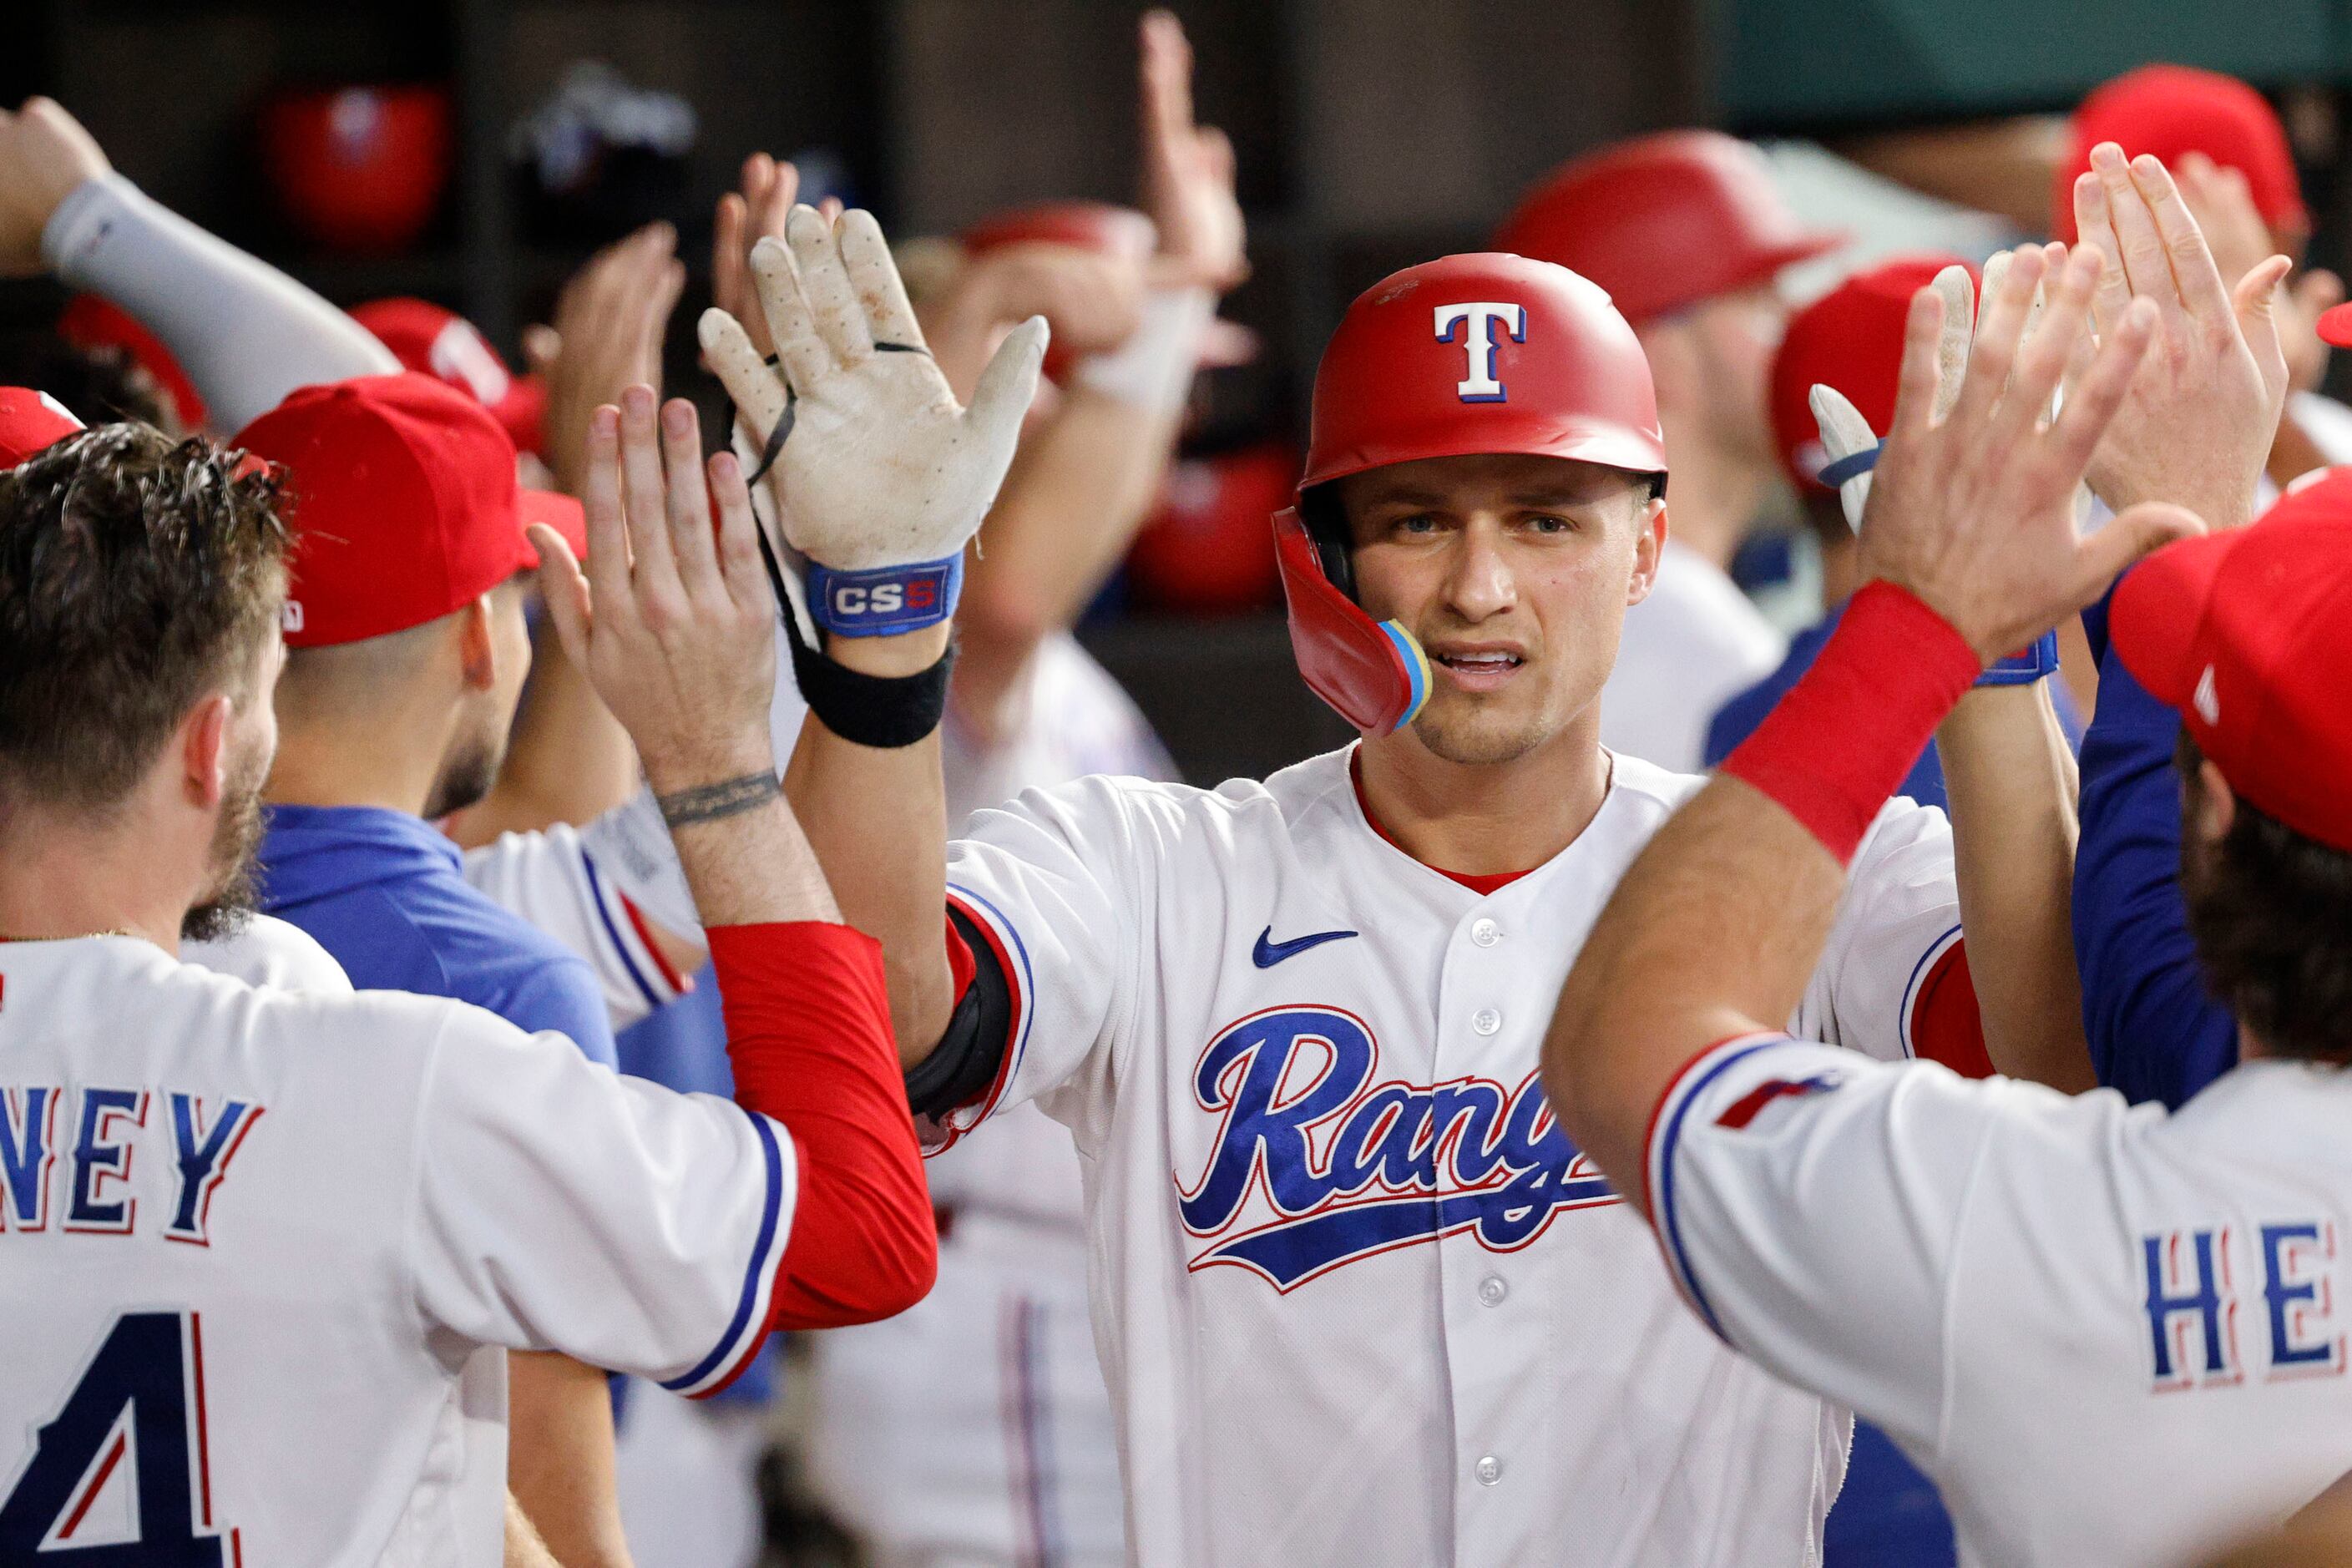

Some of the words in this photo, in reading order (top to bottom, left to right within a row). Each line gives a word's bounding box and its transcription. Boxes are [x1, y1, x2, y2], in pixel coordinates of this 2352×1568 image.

[1433, 301, 1527, 403] T
[836, 579, 936, 615] CS5
[0, 1084, 266, 1247] NEY
[2142, 1219, 2347, 1390] HE
[0, 1304, 242, 1568] 4
